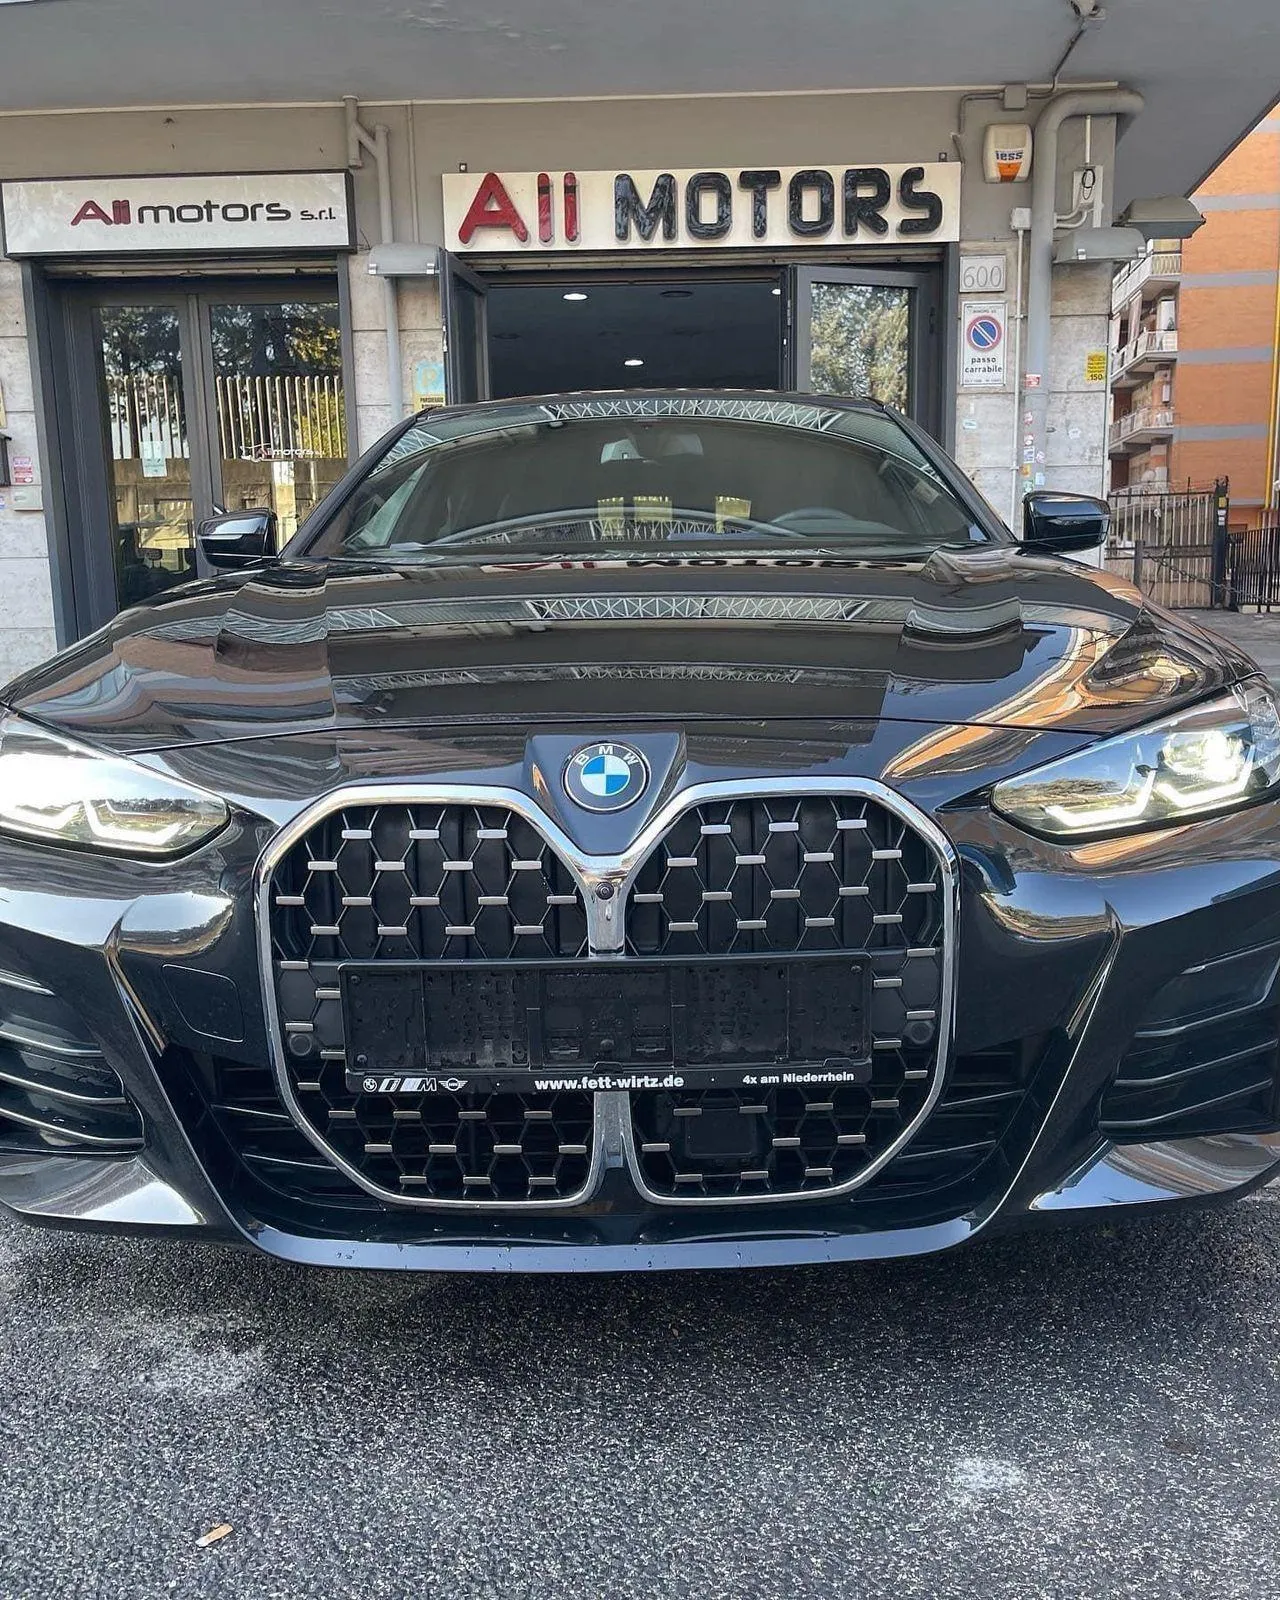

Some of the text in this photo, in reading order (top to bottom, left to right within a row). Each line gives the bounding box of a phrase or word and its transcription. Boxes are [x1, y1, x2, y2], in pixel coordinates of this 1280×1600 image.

[71, 200, 131, 225] All
[137, 200, 292, 224] motors
[458, 166, 944, 244] All MOTORS
[963, 265, 1002, 288] 600
[971, 355, 997, 365] passo
[964, 365, 1003, 373] carrabile
[574, 745, 639, 766] BMW
[535, 1075, 684, 1089] www.fett-wirtz.de
[742, 1072, 854, 1084] 4x am Niederrhein
